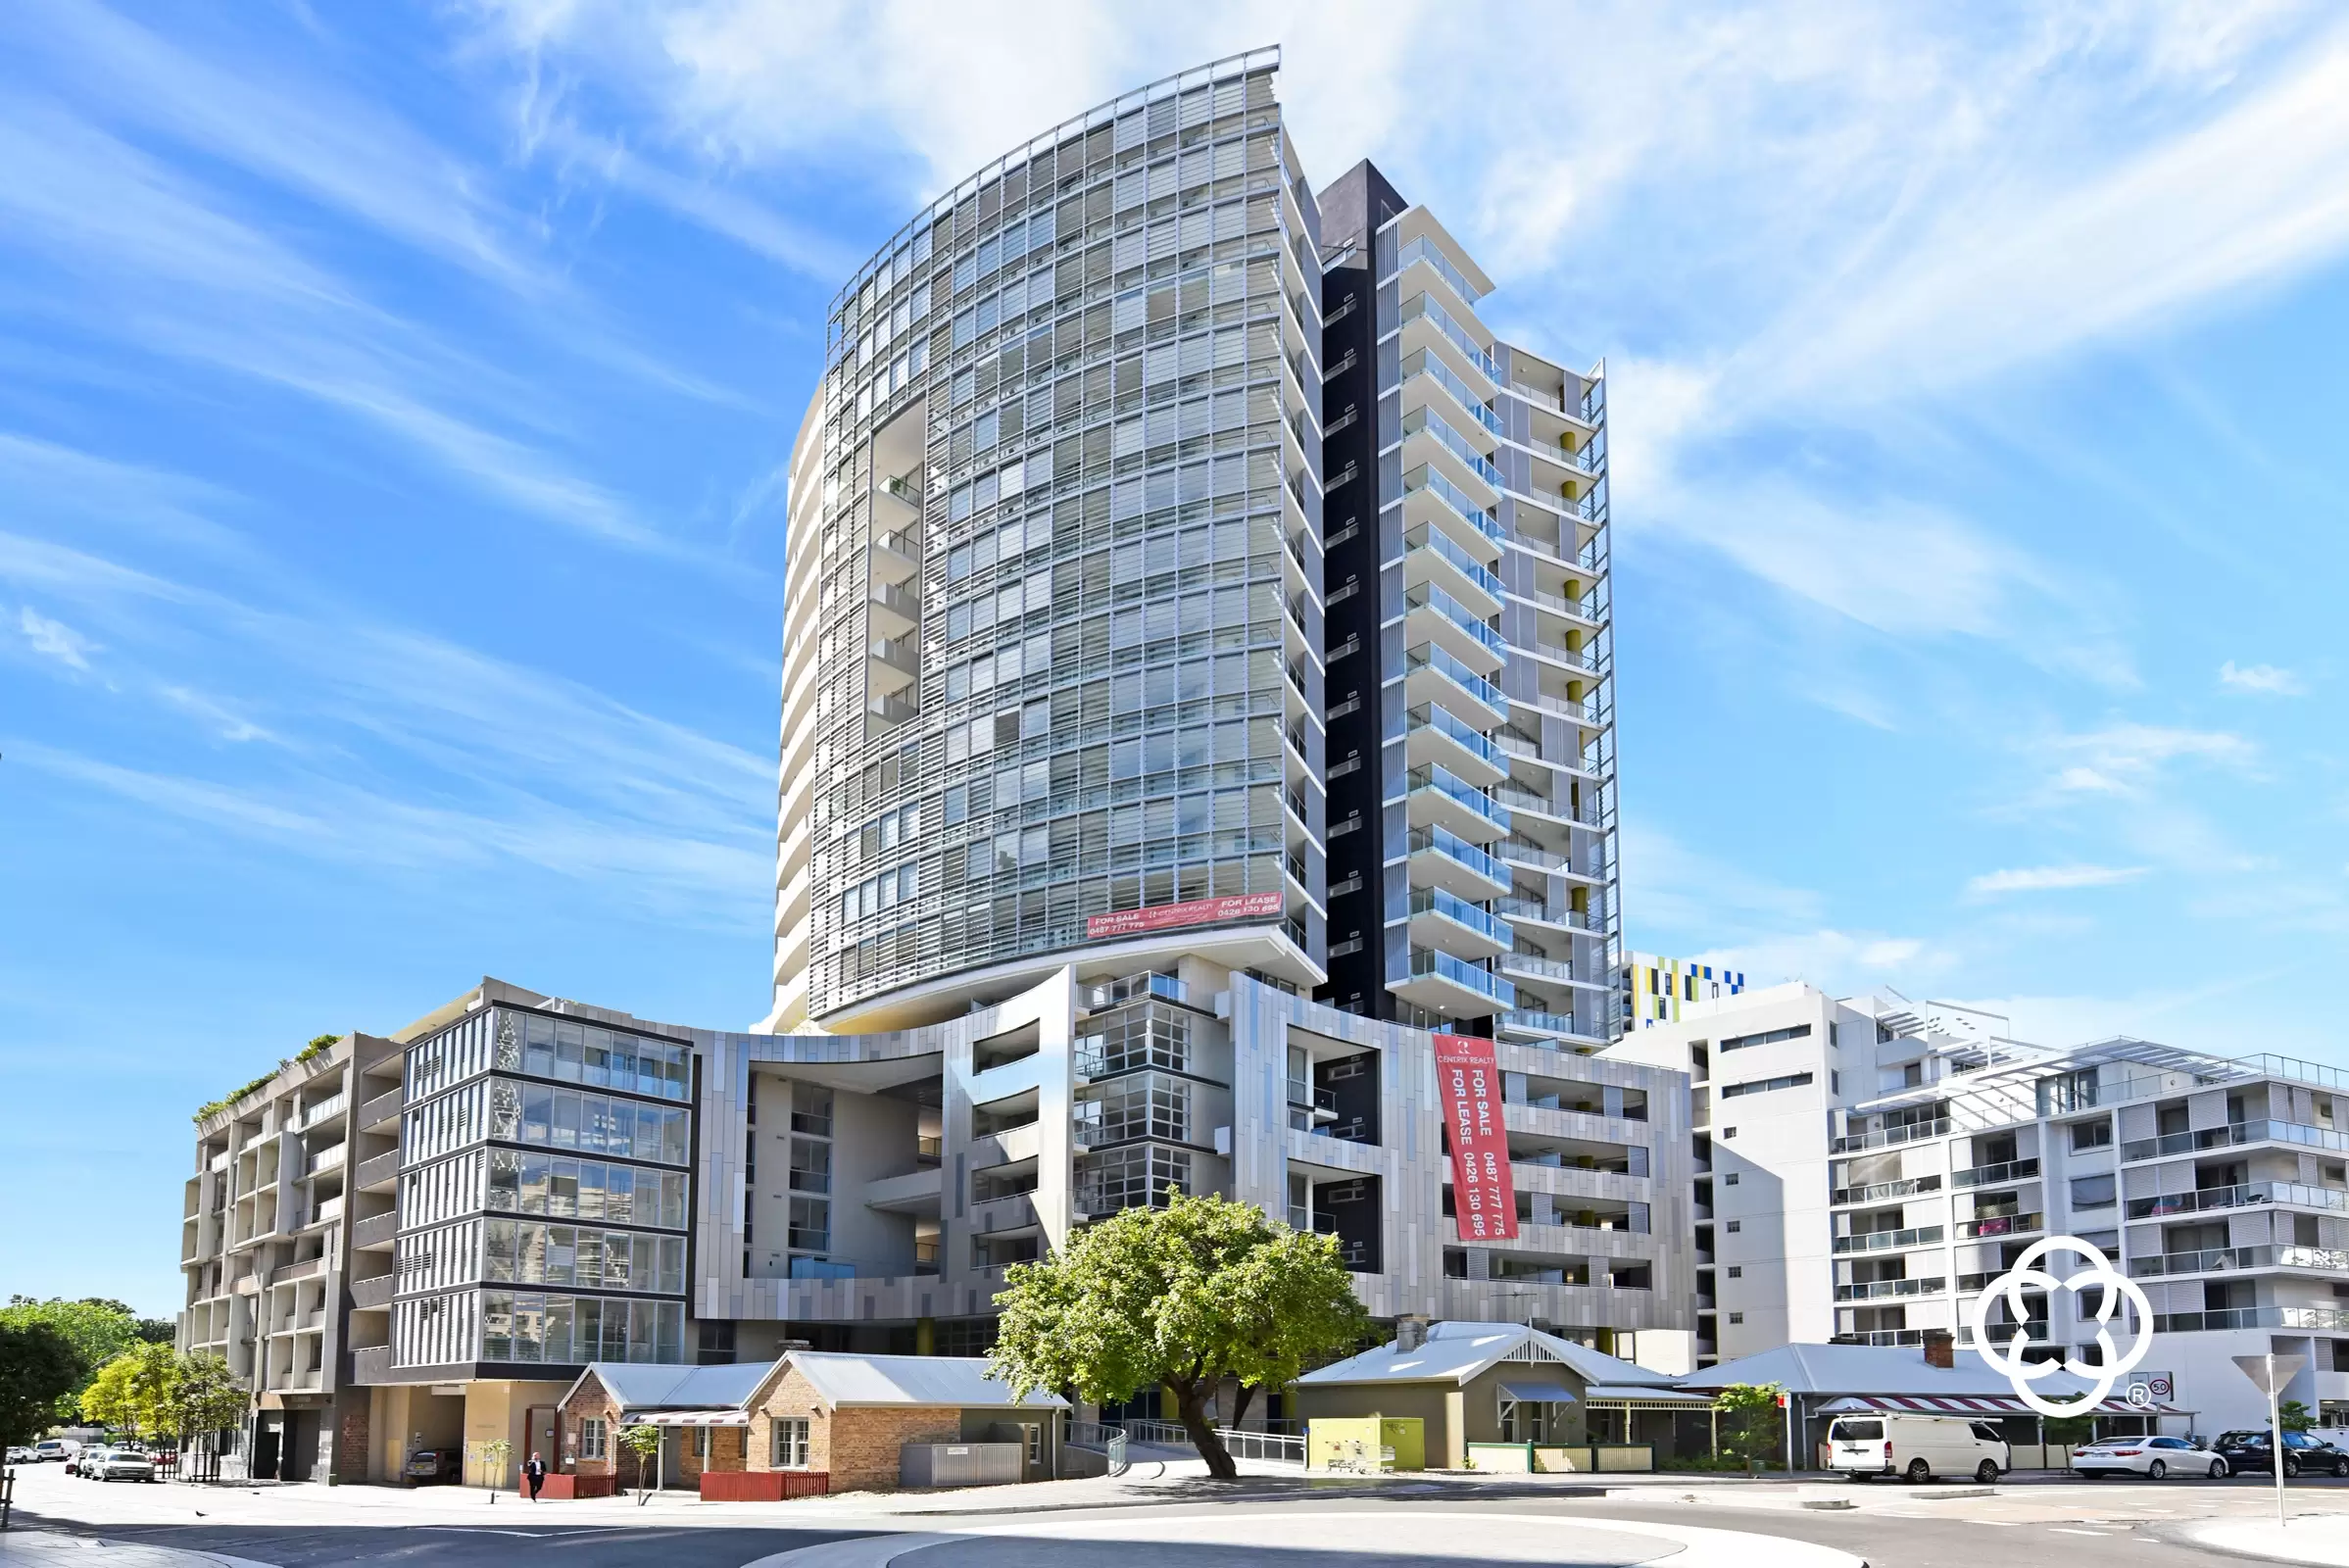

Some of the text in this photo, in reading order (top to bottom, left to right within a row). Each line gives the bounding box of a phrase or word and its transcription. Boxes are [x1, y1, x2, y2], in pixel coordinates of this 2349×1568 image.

[1221, 896, 1277, 907] FOR LEASE
[1095, 912, 1140, 925] FOR SALE
[1437, 1054, 1494, 1064] CENTRIX REALTY
[1451, 1069, 1486, 1237] FOR LEASE 0426 130 695
[1472, 1069, 1505, 1236] FOR SALE 0487 777 775
[2153, 1383, 2167, 1392] 50
